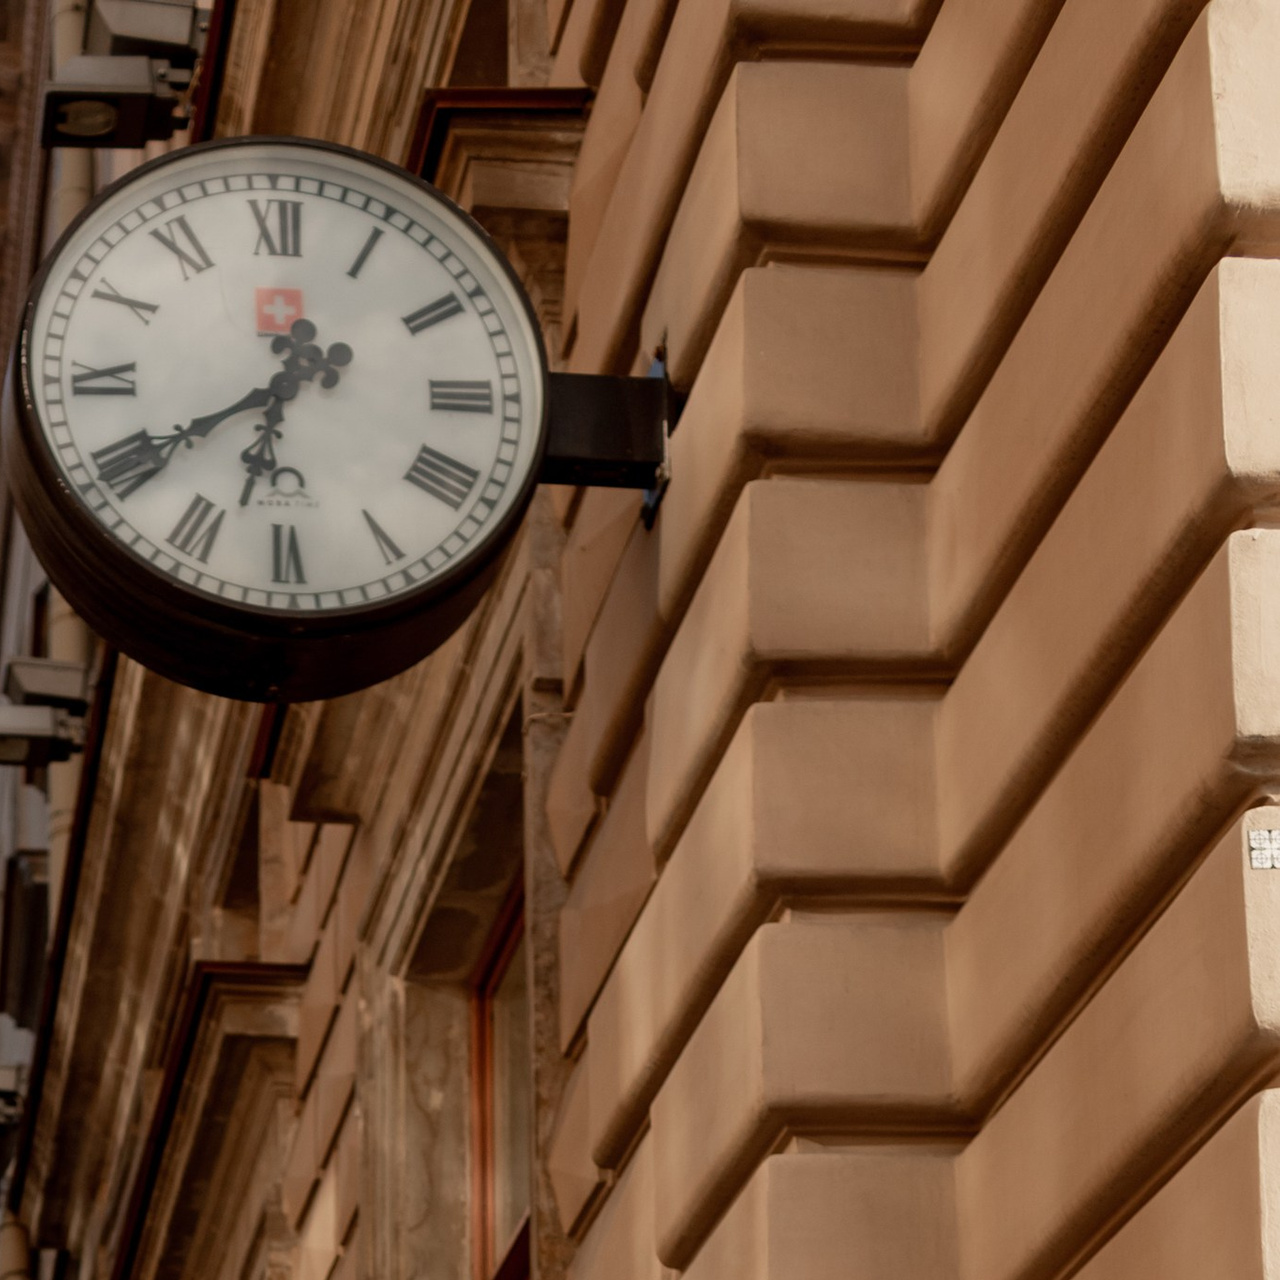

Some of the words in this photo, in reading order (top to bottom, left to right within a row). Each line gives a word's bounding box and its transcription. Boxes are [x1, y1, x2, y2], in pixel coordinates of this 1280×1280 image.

[148, 215, 216, 281] XI
[247, 199, 304, 257] XII
[346, 226, 385, 279] I
[91, 277, 160, 326] X
[401, 291, 466, 336] II
[71, 361, 137, 396] IX
[428, 379, 494, 414] III
[402, 443, 481, 512] IIII
[165, 492, 227, 564] VII
[271, 523, 308, 585] VI
[361, 509, 406, 566] V
